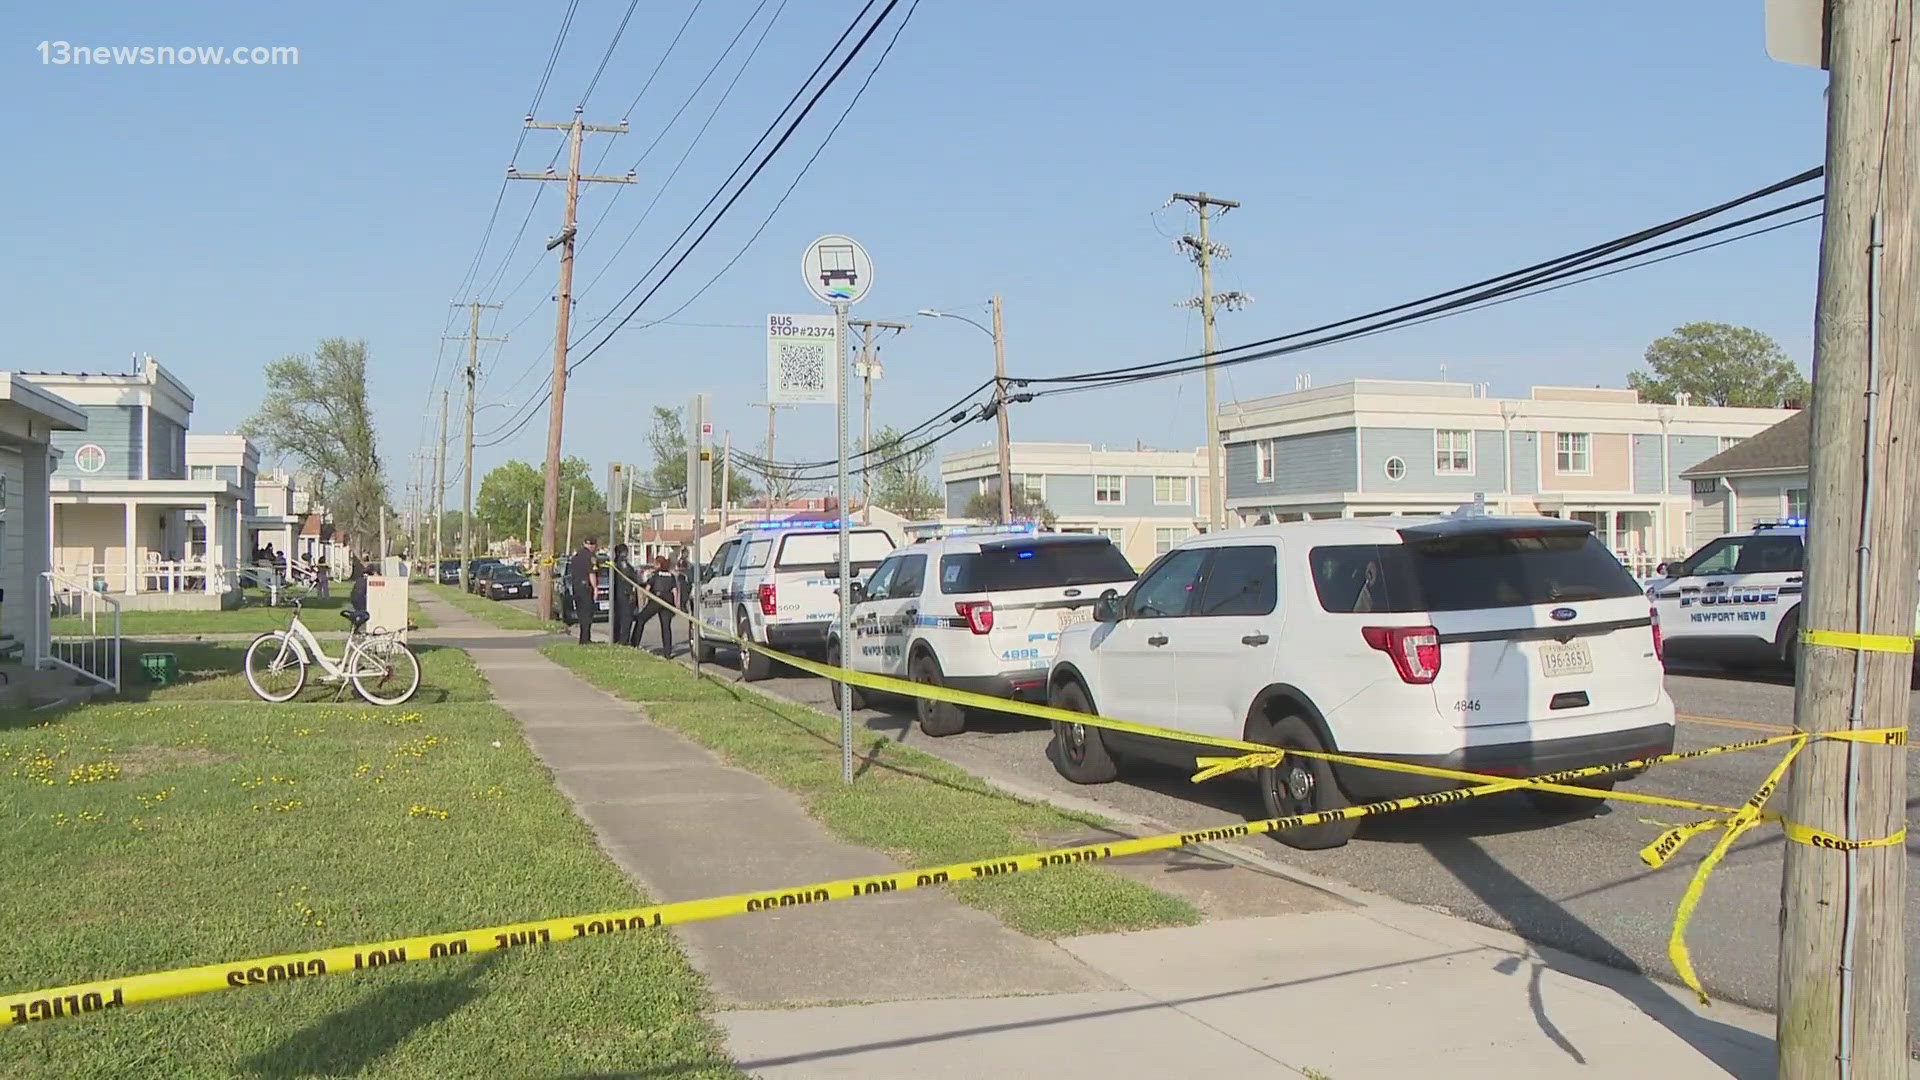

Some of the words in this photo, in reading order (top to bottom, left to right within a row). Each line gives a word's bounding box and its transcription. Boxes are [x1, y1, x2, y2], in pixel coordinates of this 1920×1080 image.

[770, 316, 792, 325] BUS
[770, 327, 799, 336] STOP
[800, 327, 835, 337] #2374
[1680, 585, 1779, 608] POLICE
[937, 618, 950, 628] 911
[1691, 612, 1734, 623] NEWPORT
[1737, 611, 1766, 621] NEWS
[1453, 699, 1480, 711] 4846
[11, 988, 123, 1026] POLICE
